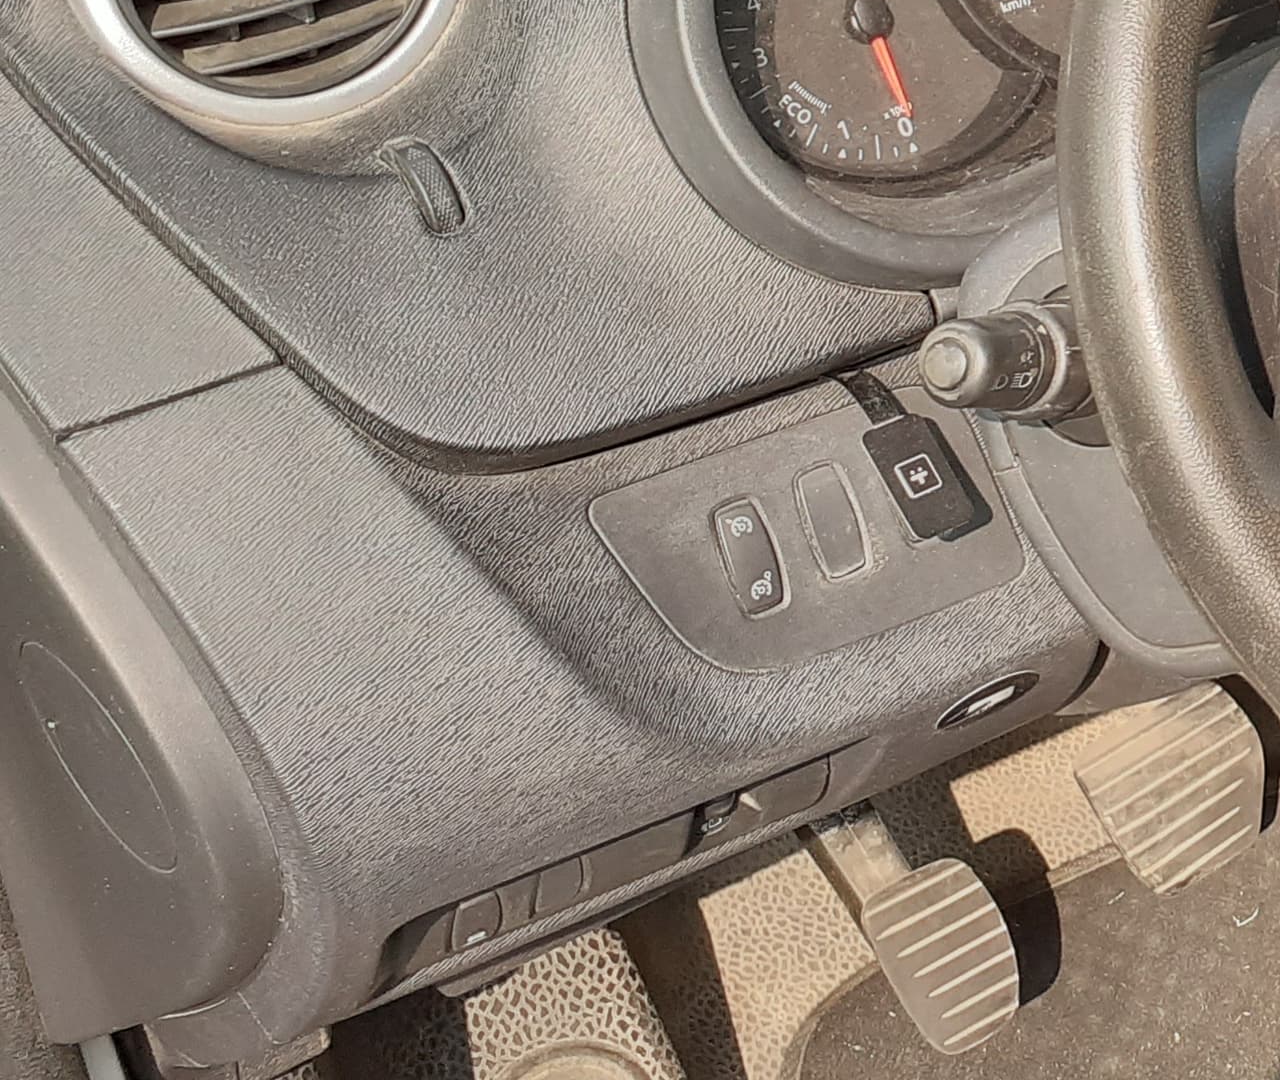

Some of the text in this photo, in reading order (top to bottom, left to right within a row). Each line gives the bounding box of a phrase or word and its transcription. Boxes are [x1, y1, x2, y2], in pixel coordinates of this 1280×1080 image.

[752, 47, 768, 68] 3
[778, 94, 812, 124] ECO
[837, 120, 850, 140] 1
[897, 117, 914, 137] 0
